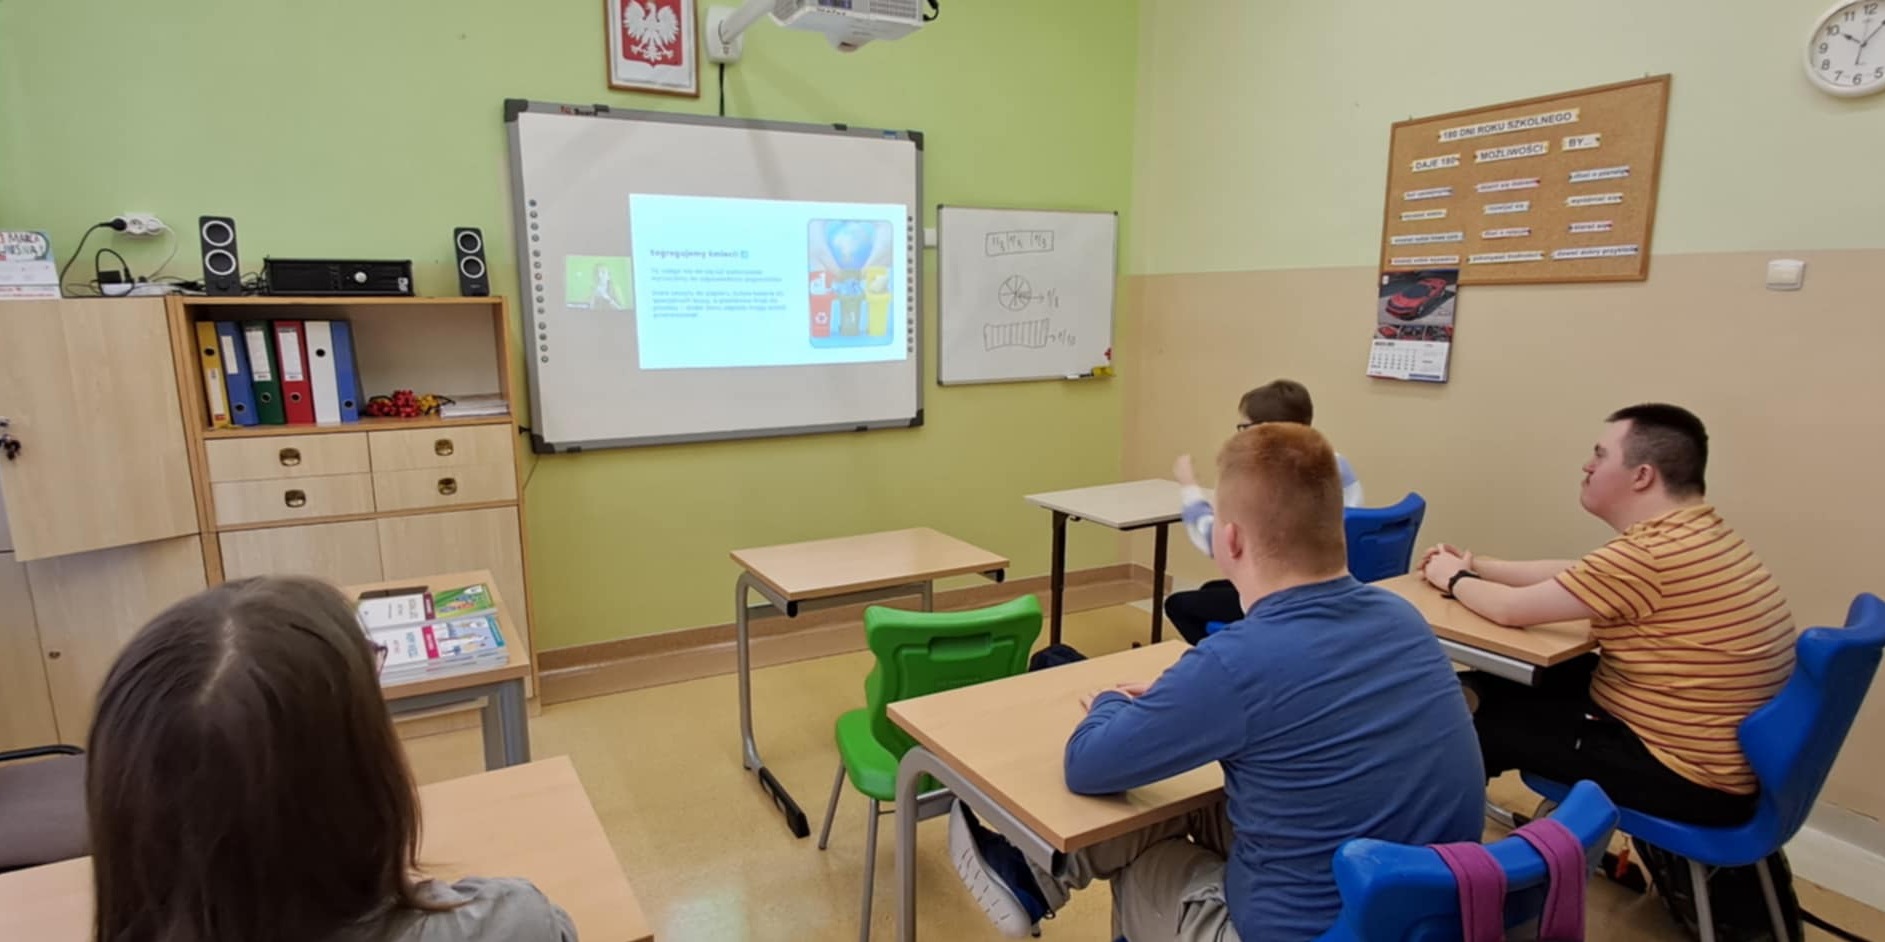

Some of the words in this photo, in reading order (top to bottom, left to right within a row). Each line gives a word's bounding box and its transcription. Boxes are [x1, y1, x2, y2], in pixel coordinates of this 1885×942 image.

[1864, 2, 1878, 15] 12
[1844, 11, 1855, 22] 11
[1826, 24, 1840, 36] 10
[1818, 42, 1829, 54] 9
[1821, 59, 1831, 71] 8
[1834, 70, 1844, 81] 7
[1874, 67, 1885, 79] 5
[1852, 73, 1862, 86] 6
[1443, 129, 1458, 139] 180
[1460, 127, 1476, 137] DNI
[1477, 122, 1505, 134] ROKU
[1508, 111, 1572, 129] SZKOLNEGO
[1415, 159, 1438, 170] DAJE
